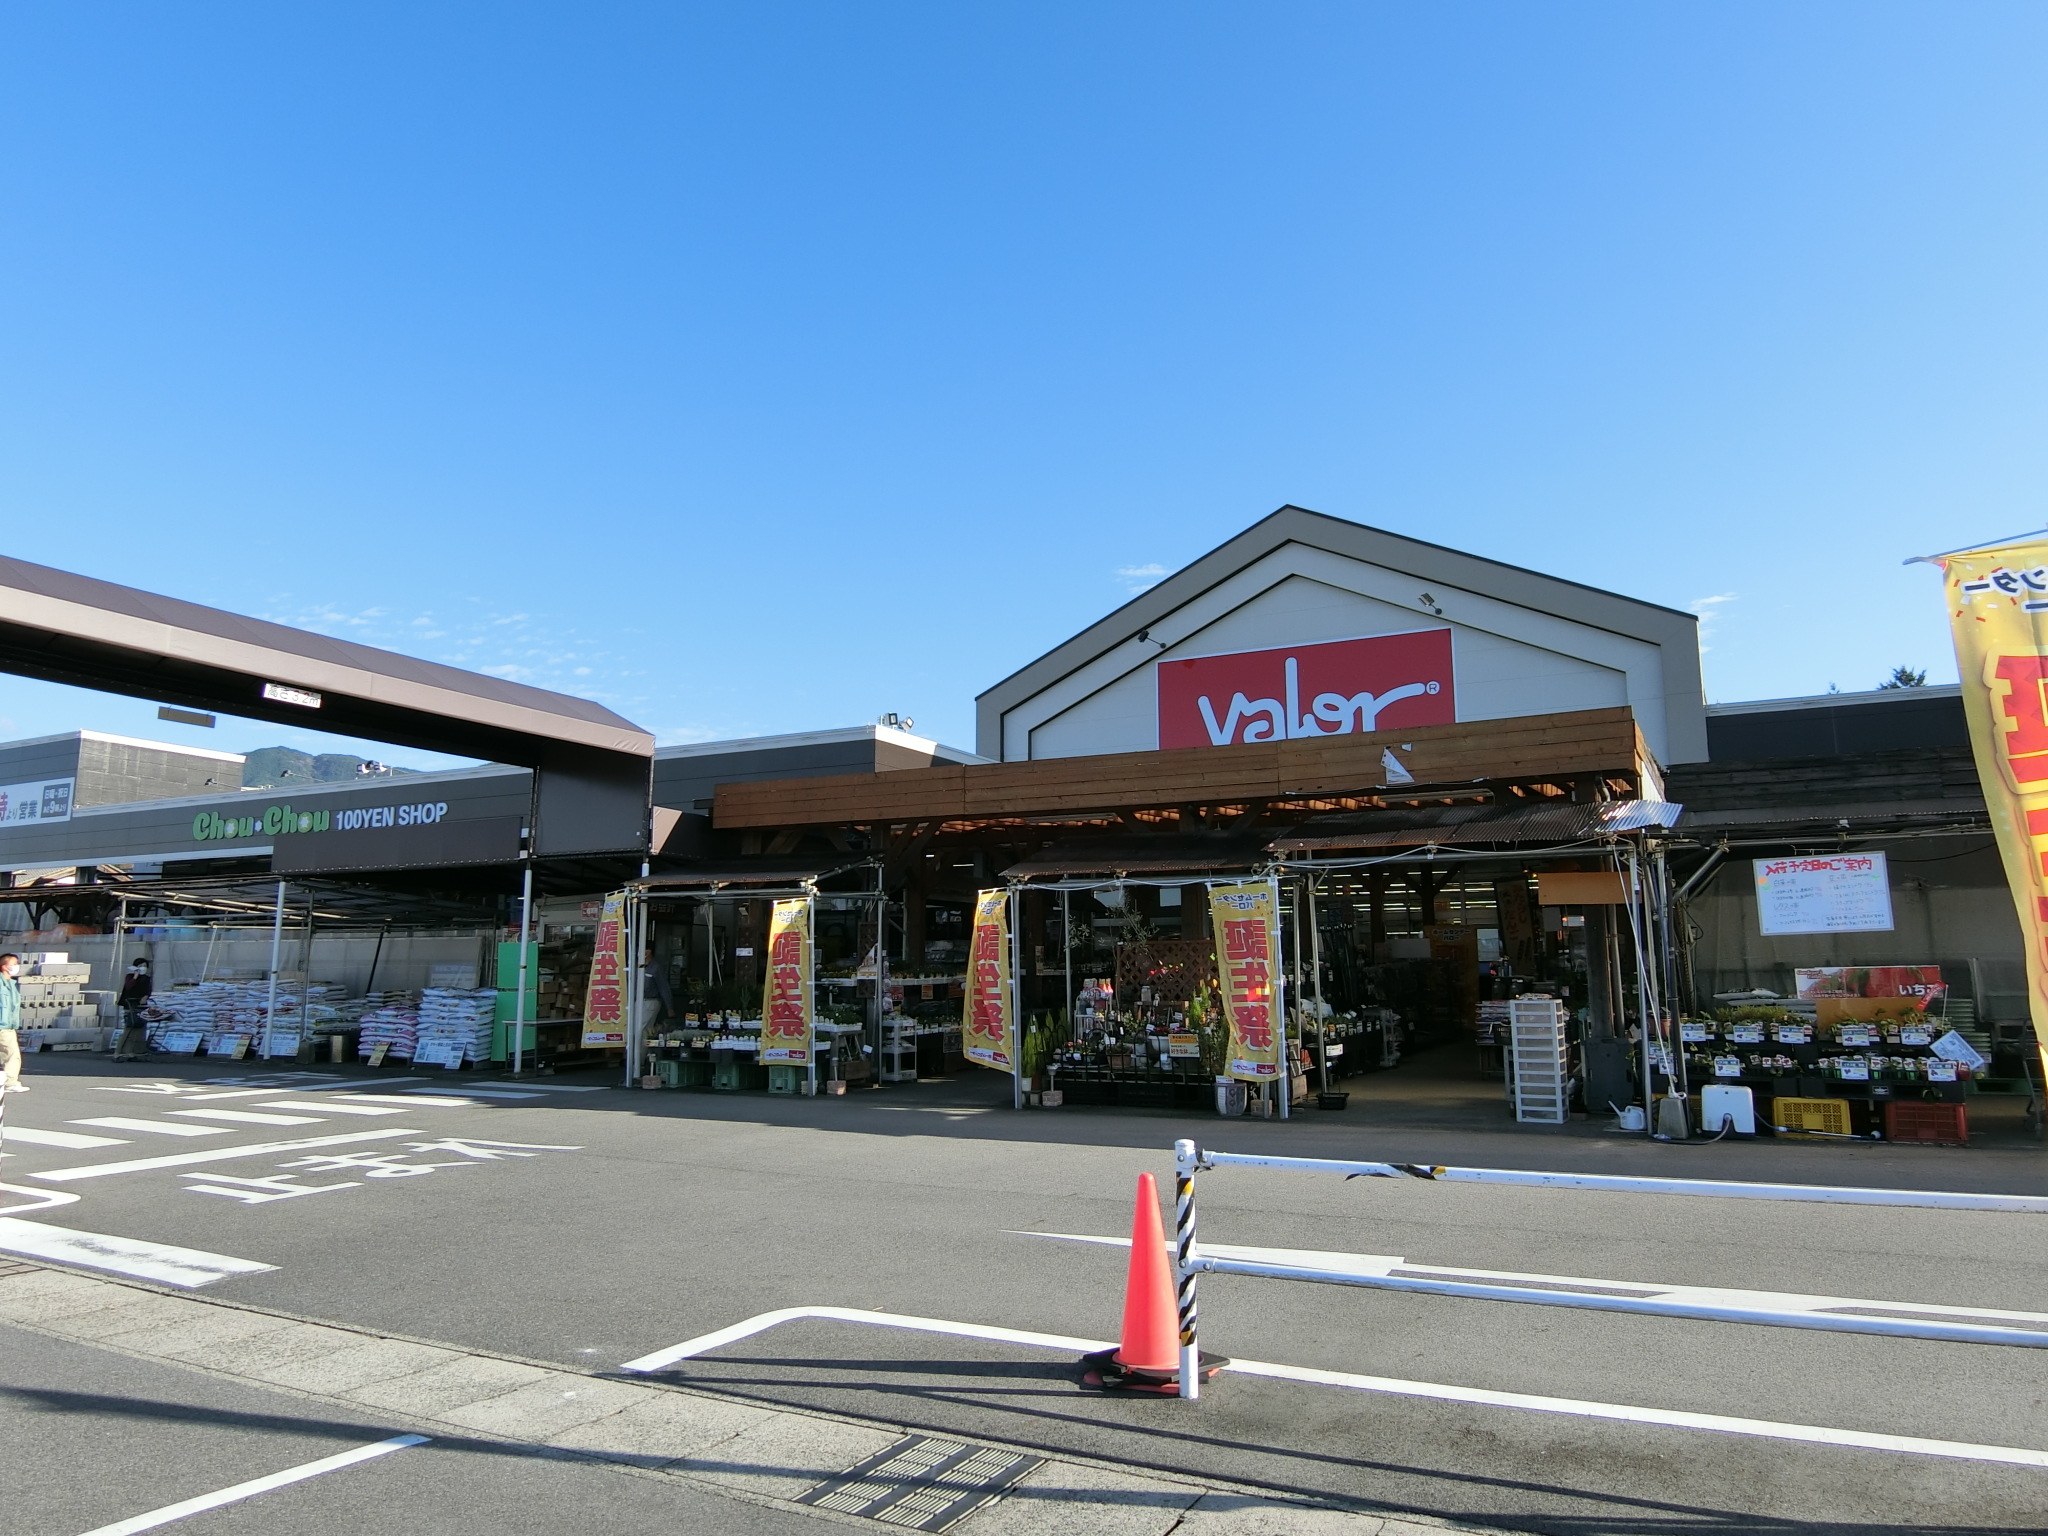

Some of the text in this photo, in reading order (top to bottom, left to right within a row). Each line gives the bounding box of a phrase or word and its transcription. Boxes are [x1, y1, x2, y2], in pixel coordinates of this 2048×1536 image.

[335, 806, 395, 831] 100YEN
[398, 801, 448, 826] SHOP
[1765, 856, 1873, 877] 入荷予定日のご案内
[177, 1135, 587, 1206] 止まれ
